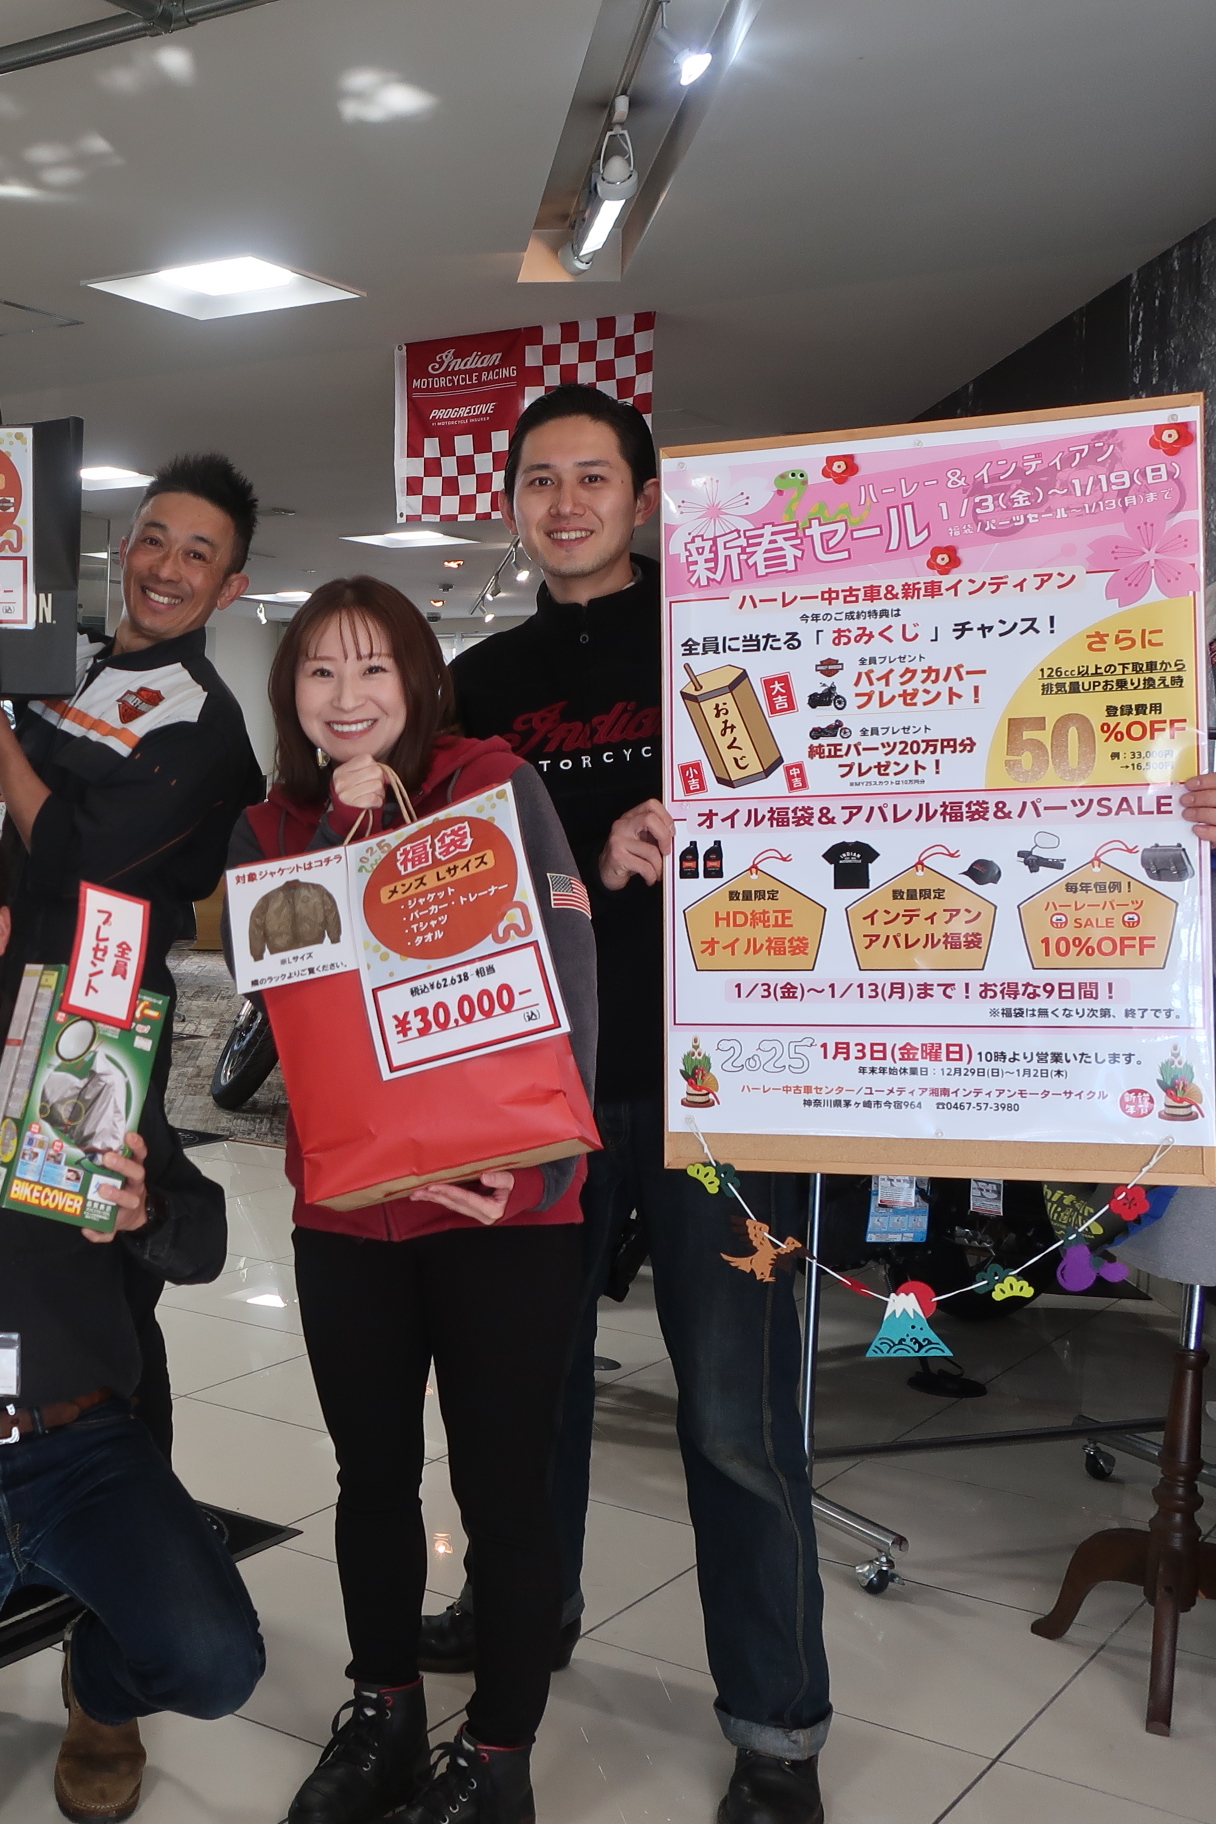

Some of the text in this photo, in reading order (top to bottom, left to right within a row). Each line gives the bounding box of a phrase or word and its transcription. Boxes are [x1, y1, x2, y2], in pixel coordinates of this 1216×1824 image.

[428, 348, 503, 374] Indian
[412, 366, 517, 389] MOTORCYCLE RACING
[429, 402, 496, 420] PROGRESSIVE
[685, 502, 932, 588] 新春セール
[737, 570, 1077, 611] ハーレー中古車&新車インディアン
[799, 608, 902, 624] 今年のご成約特典は
[1085, 628, 1164, 653] さらに
[858, 653, 926, 666] 全員プレゼント
[1038, 659, 1186, 679] 126cc以上の下取車から
[853, 664, 987, 688] バイクカバー
[1041, 675, 1184, 695] 排気量UPお乗り換え時
[769, 680, 788, 711] 大吉
[854, 685, 981, 710] プレゼント！
[1105, 702, 1163, 718] 登録費用
[713, 702, 750, 770] おみくじ
[859, 724, 932, 737] 全員プレゼント
[538, 746, 653, 772] TORCYC
[807, 737, 977, 760] 純正パーツ20万円分
[1004, 712, 1188, 784] 50 %OFF
[685, 766, 700, 790] 小吉
[789, 767, 803, 788] 中吉
[838, 759, 941, 779] プレゼント！
[396, 820, 474, 876] 福袋
[235, 854, 343, 885] 対象ジャケットはコチラ
[387, 853, 488, 900] メンズ Lサイズ
[728, 889, 780, 902] 数量限定
[891, 888, 946, 901] 数量限定
[713, 909, 794, 929] HD純正
[861, 908, 982, 927] インディアン
[1073, 917, 1115, 929] SALE
[84, 909, 113, 997] プレゼント
[699, 936, 810, 957] オイル福袋
[862, 932, 983, 951] アパレル福袋
[1040, 935, 1157, 957] 10%OFF
[111, 940, 133, 981] 全員
[819, 1041, 1143, 1066] 1月3日(金曜日) 10時より営業いたします。
[9, 1178, 42, 1203] BIKE
[38, 1185, 84, 1215] COVER
